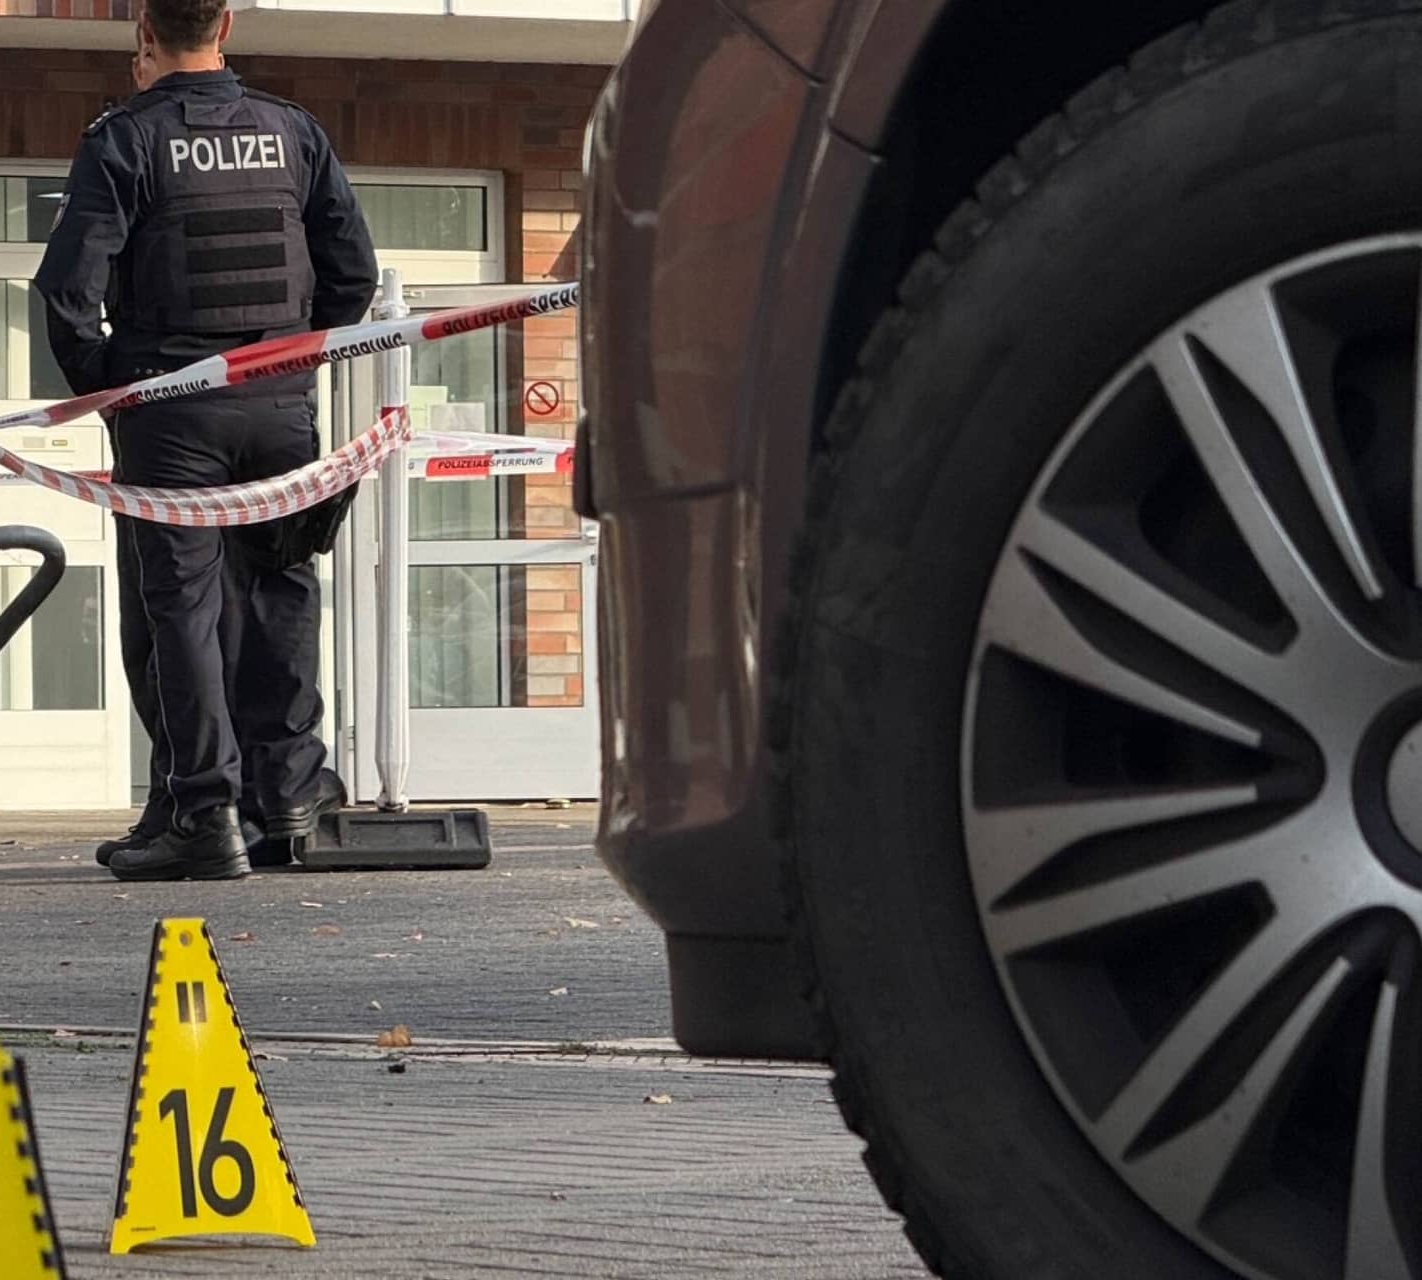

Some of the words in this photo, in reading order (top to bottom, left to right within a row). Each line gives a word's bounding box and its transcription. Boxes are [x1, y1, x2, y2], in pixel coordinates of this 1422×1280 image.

[170, 134, 285, 173] POLIZEI
[438, 457, 544, 470] POLIZEIABSPERRUNG
[159, 1087, 256, 1219] 16
